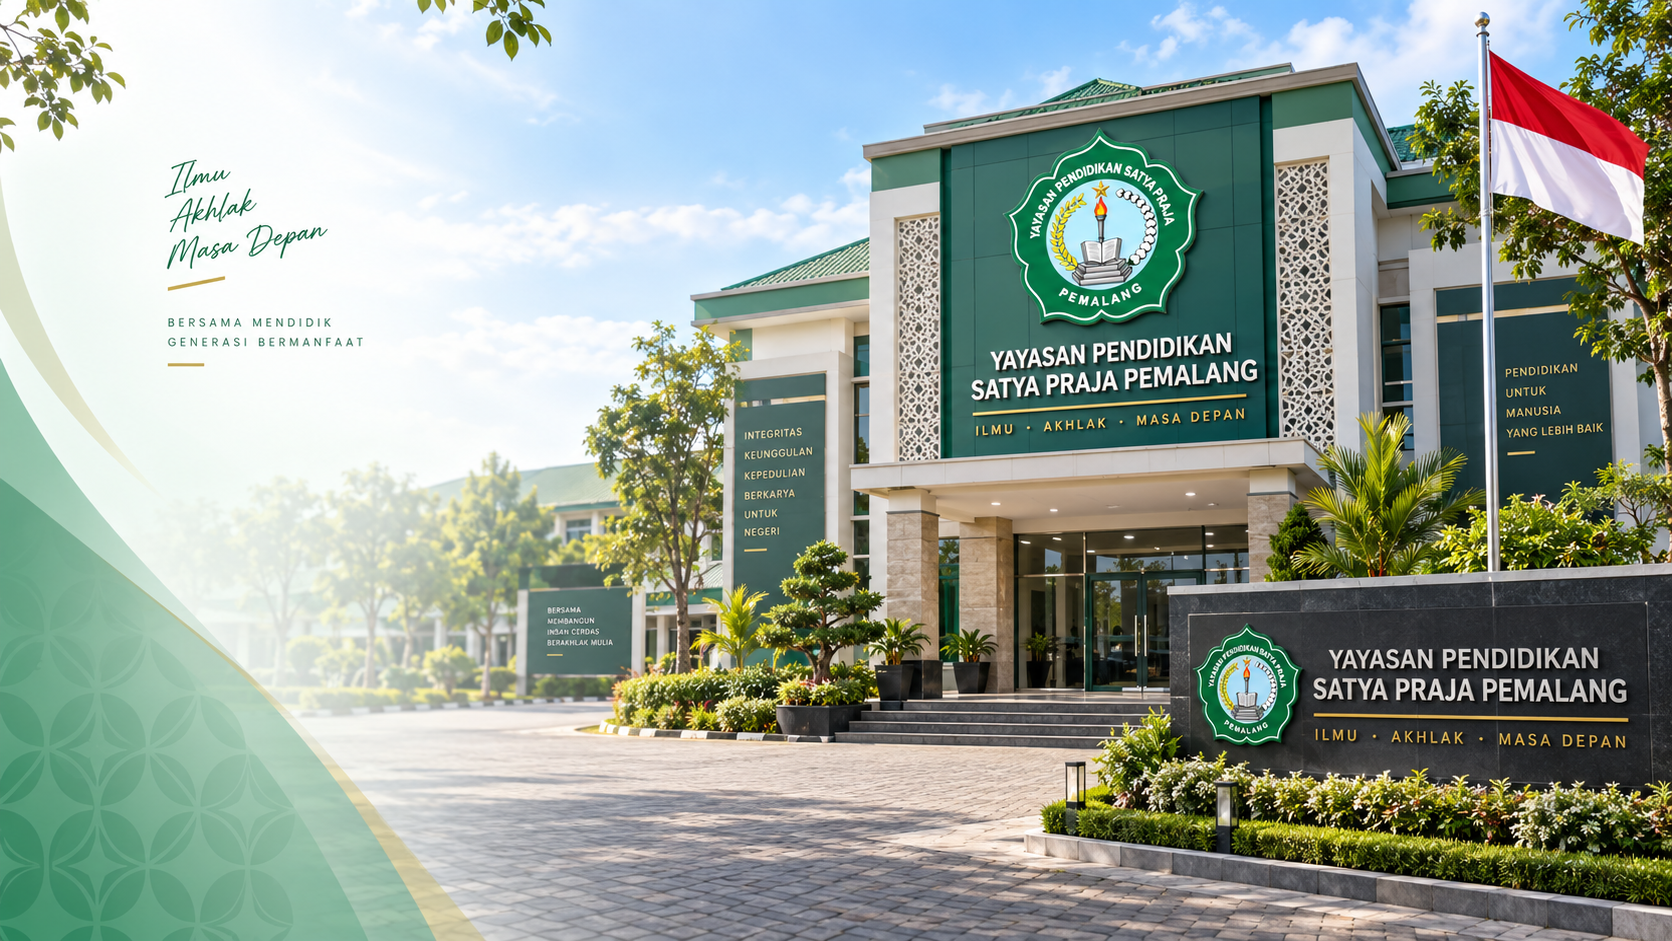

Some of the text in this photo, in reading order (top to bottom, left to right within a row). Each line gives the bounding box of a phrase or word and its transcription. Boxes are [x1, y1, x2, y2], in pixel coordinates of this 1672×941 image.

[1030, 162, 1176, 240] YAYASAN PENDIDIKAN SATYA PRAJA
[1058, 282, 1142, 306] PEMALANG
[990, 332, 1232, 372] YAYASAN PENDIDIKAN
[1505, 363, 1578, 378] PENDIDIKAN
[971, 358, 1258, 401] SATYA PRAJA PEMALANG
[1505, 386, 1546, 398] UNTUK
[1506, 405, 1562, 418] MANUSIA
[976, 408, 1246, 436] ILMU AKHLAK MASA DEPAN
[744, 427, 802, 440] INTEGRITAS
[1506, 422, 1604, 438] YANG LEBIH BAIK
[744, 446, 813, 460] KEUNGGULAN
[744, 468, 806, 480] KEPEDULIAN
[744, 488, 796, 500] BERKARYA
[744, 508, 778, 519] UNTUK
[744, 526, 780, 537] NEGERI
[1328, 647, 1599, 670] YAYASAN PENDIDIKAN
[1313, 678, 1627, 703] SATYA PRAJA PEMALANG
[1223, 720, 1268, 734] PEMALANG
[1314, 728, 1626, 748] ILMU AKHLAK MASA DEPAN
